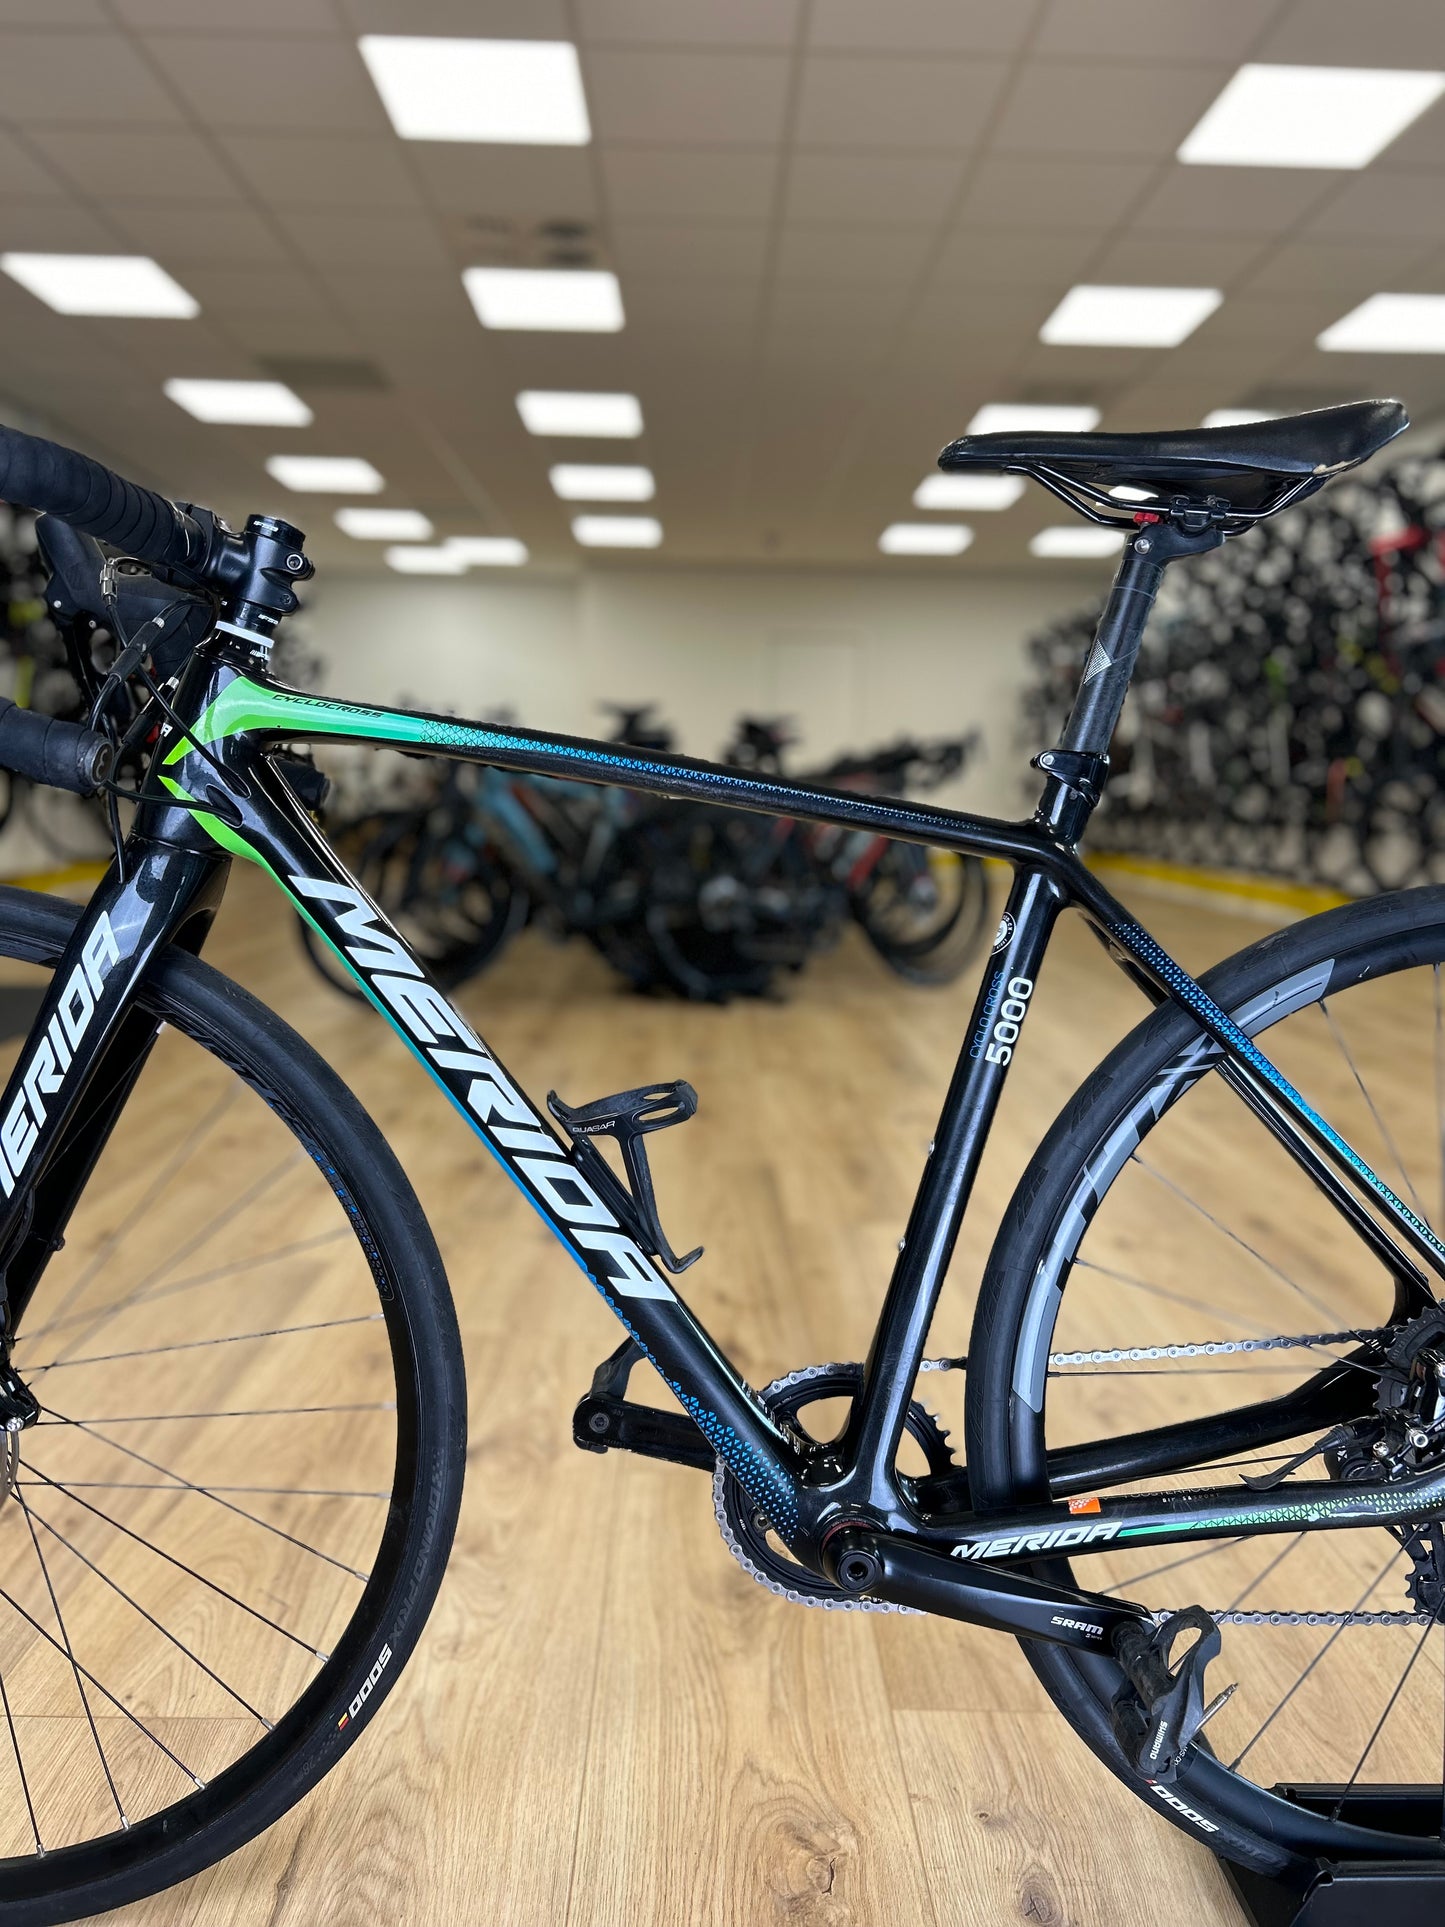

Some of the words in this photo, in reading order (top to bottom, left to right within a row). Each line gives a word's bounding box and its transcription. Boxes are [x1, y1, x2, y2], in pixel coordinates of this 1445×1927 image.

[272, 694, 384, 718] CYCLOCROSS
[969, 1016, 990, 1059] CYCLO
[983, 970, 1006, 1020] CROSS
[985, 976, 1034, 1067] 5000
[288, 875, 678, 1302] MERIDA
[572, 1120, 616, 1133] QUASAR
[950, 1521, 1123, 1560] MERIDA
[1050, 1615, 1104, 1635] SRAM
[348, 1643, 393, 1719] 5000
[1149, 1720, 1168, 1760] SHIMANO
[1150, 1785, 1220, 1833] 5000
